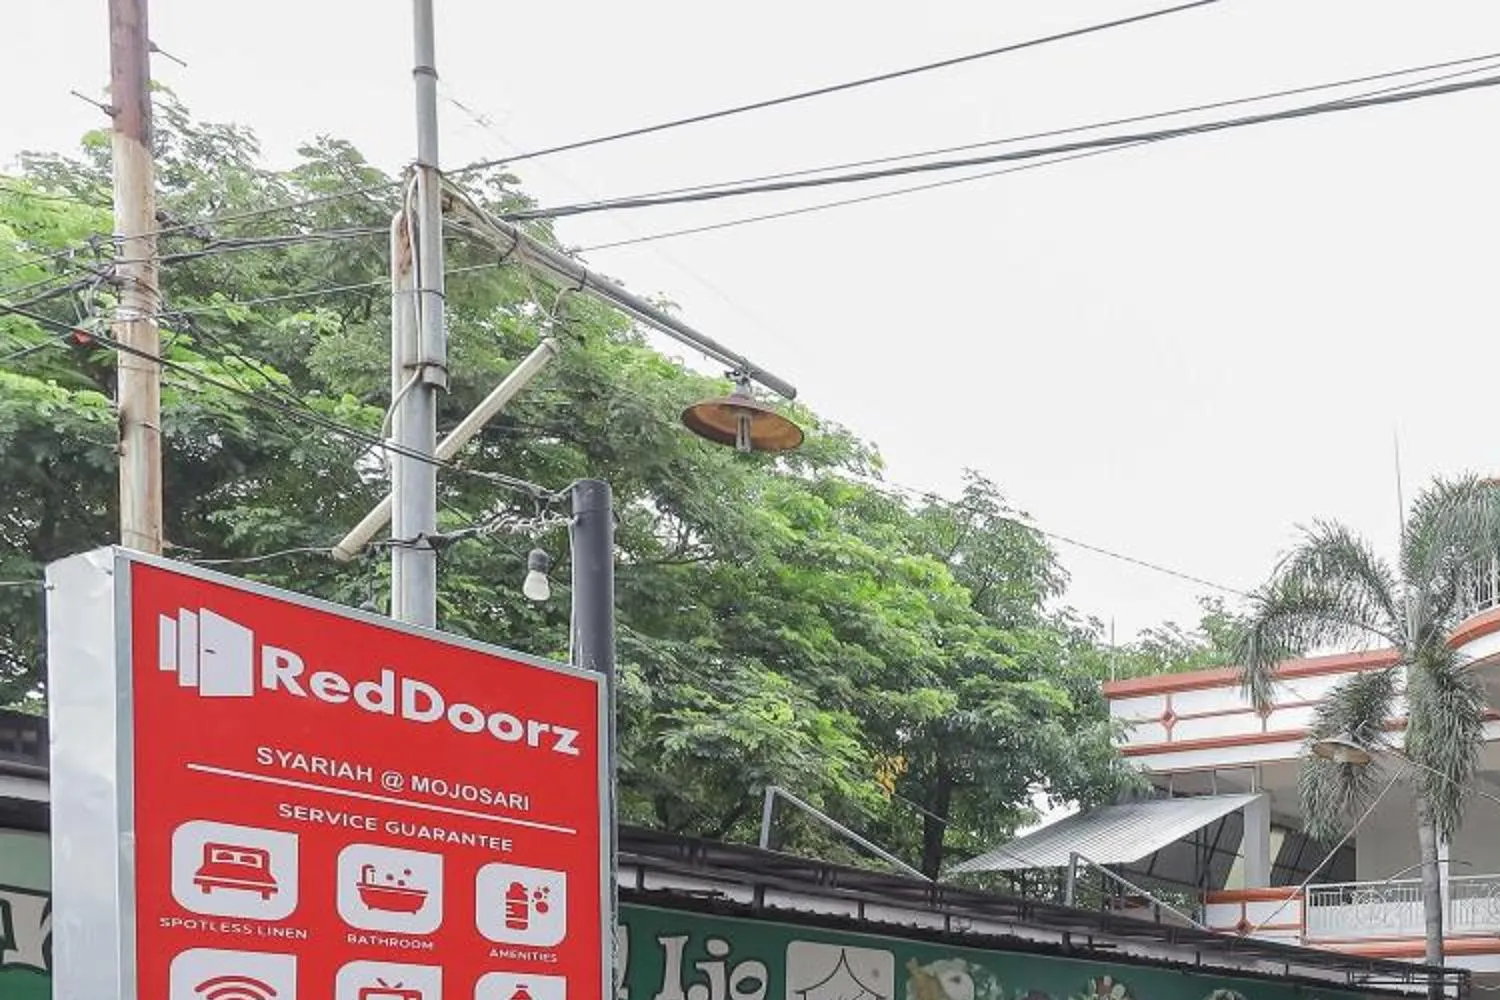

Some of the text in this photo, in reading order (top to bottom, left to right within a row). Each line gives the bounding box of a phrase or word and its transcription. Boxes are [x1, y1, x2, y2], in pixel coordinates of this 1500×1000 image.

[261, 645, 580, 756] RedDoorz
[256, 746, 530, 811] SYARIAH @ MOJOSARI
[279, 802, 514, 852] SERVICE GUARANTEE
[159, 916, 309, 941] SPOTLESS LINEN
[346, 933, 435, 951] BATHROOM
[489, 948, 559, 964] AMENITIES
